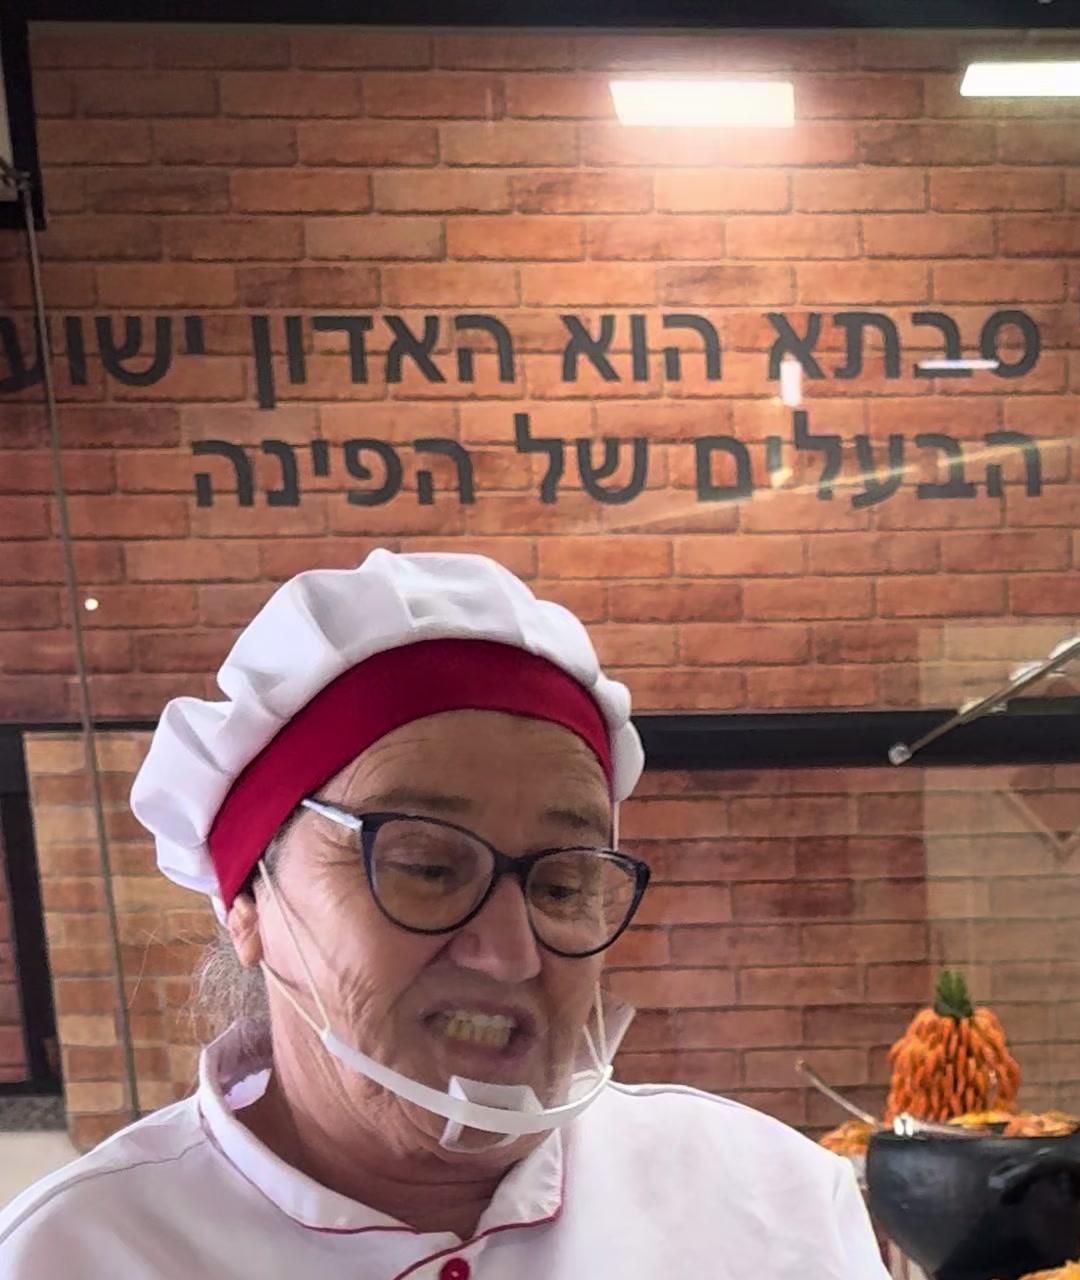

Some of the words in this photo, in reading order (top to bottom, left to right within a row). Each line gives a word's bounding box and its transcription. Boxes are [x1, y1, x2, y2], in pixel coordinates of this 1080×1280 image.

[0, 315, 205, 393] ישוע
[252, 314, 516, 409] האדון
[562, 313, 721, 382] הוא
[767, 311, 1041, 380] סבתא
[192, 437, 475, 507] הפינה
[515, 413, 649, 505] של
[697, 410, 1041, 509] הבעלים
